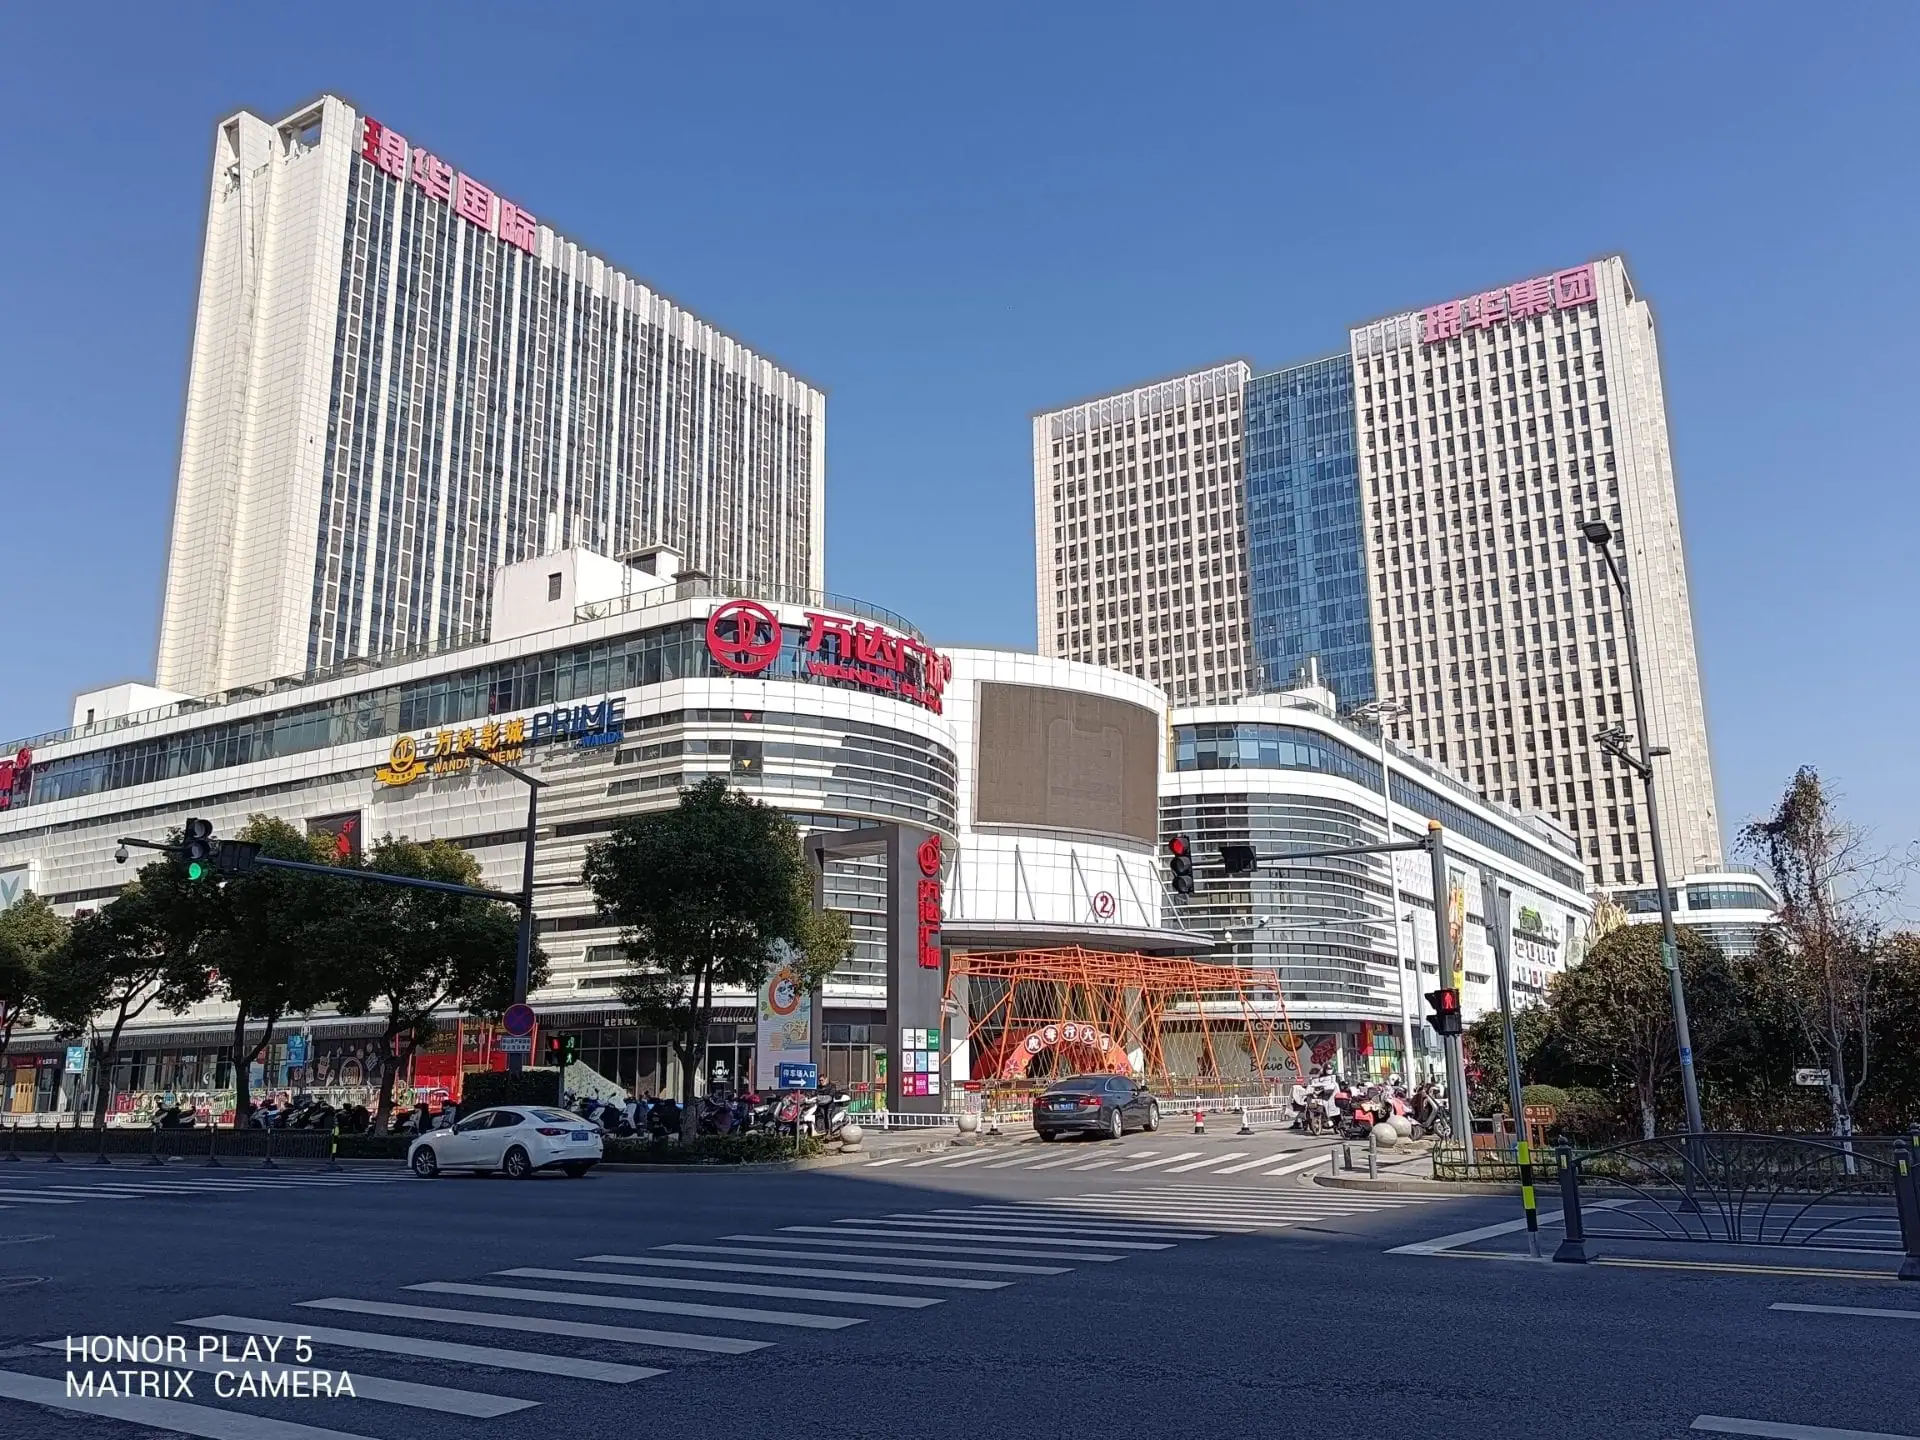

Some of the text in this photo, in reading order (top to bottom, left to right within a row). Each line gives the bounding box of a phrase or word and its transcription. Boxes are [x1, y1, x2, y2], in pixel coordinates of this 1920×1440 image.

[805, 660, 895, 691] WANDA
[532, 696, 627, 743] PRIME
[434, 716, 525, 757] 万达影城
[432, 756, 471, 774] WANDA
[783, 1069, 815, 1078] 停车场入口
